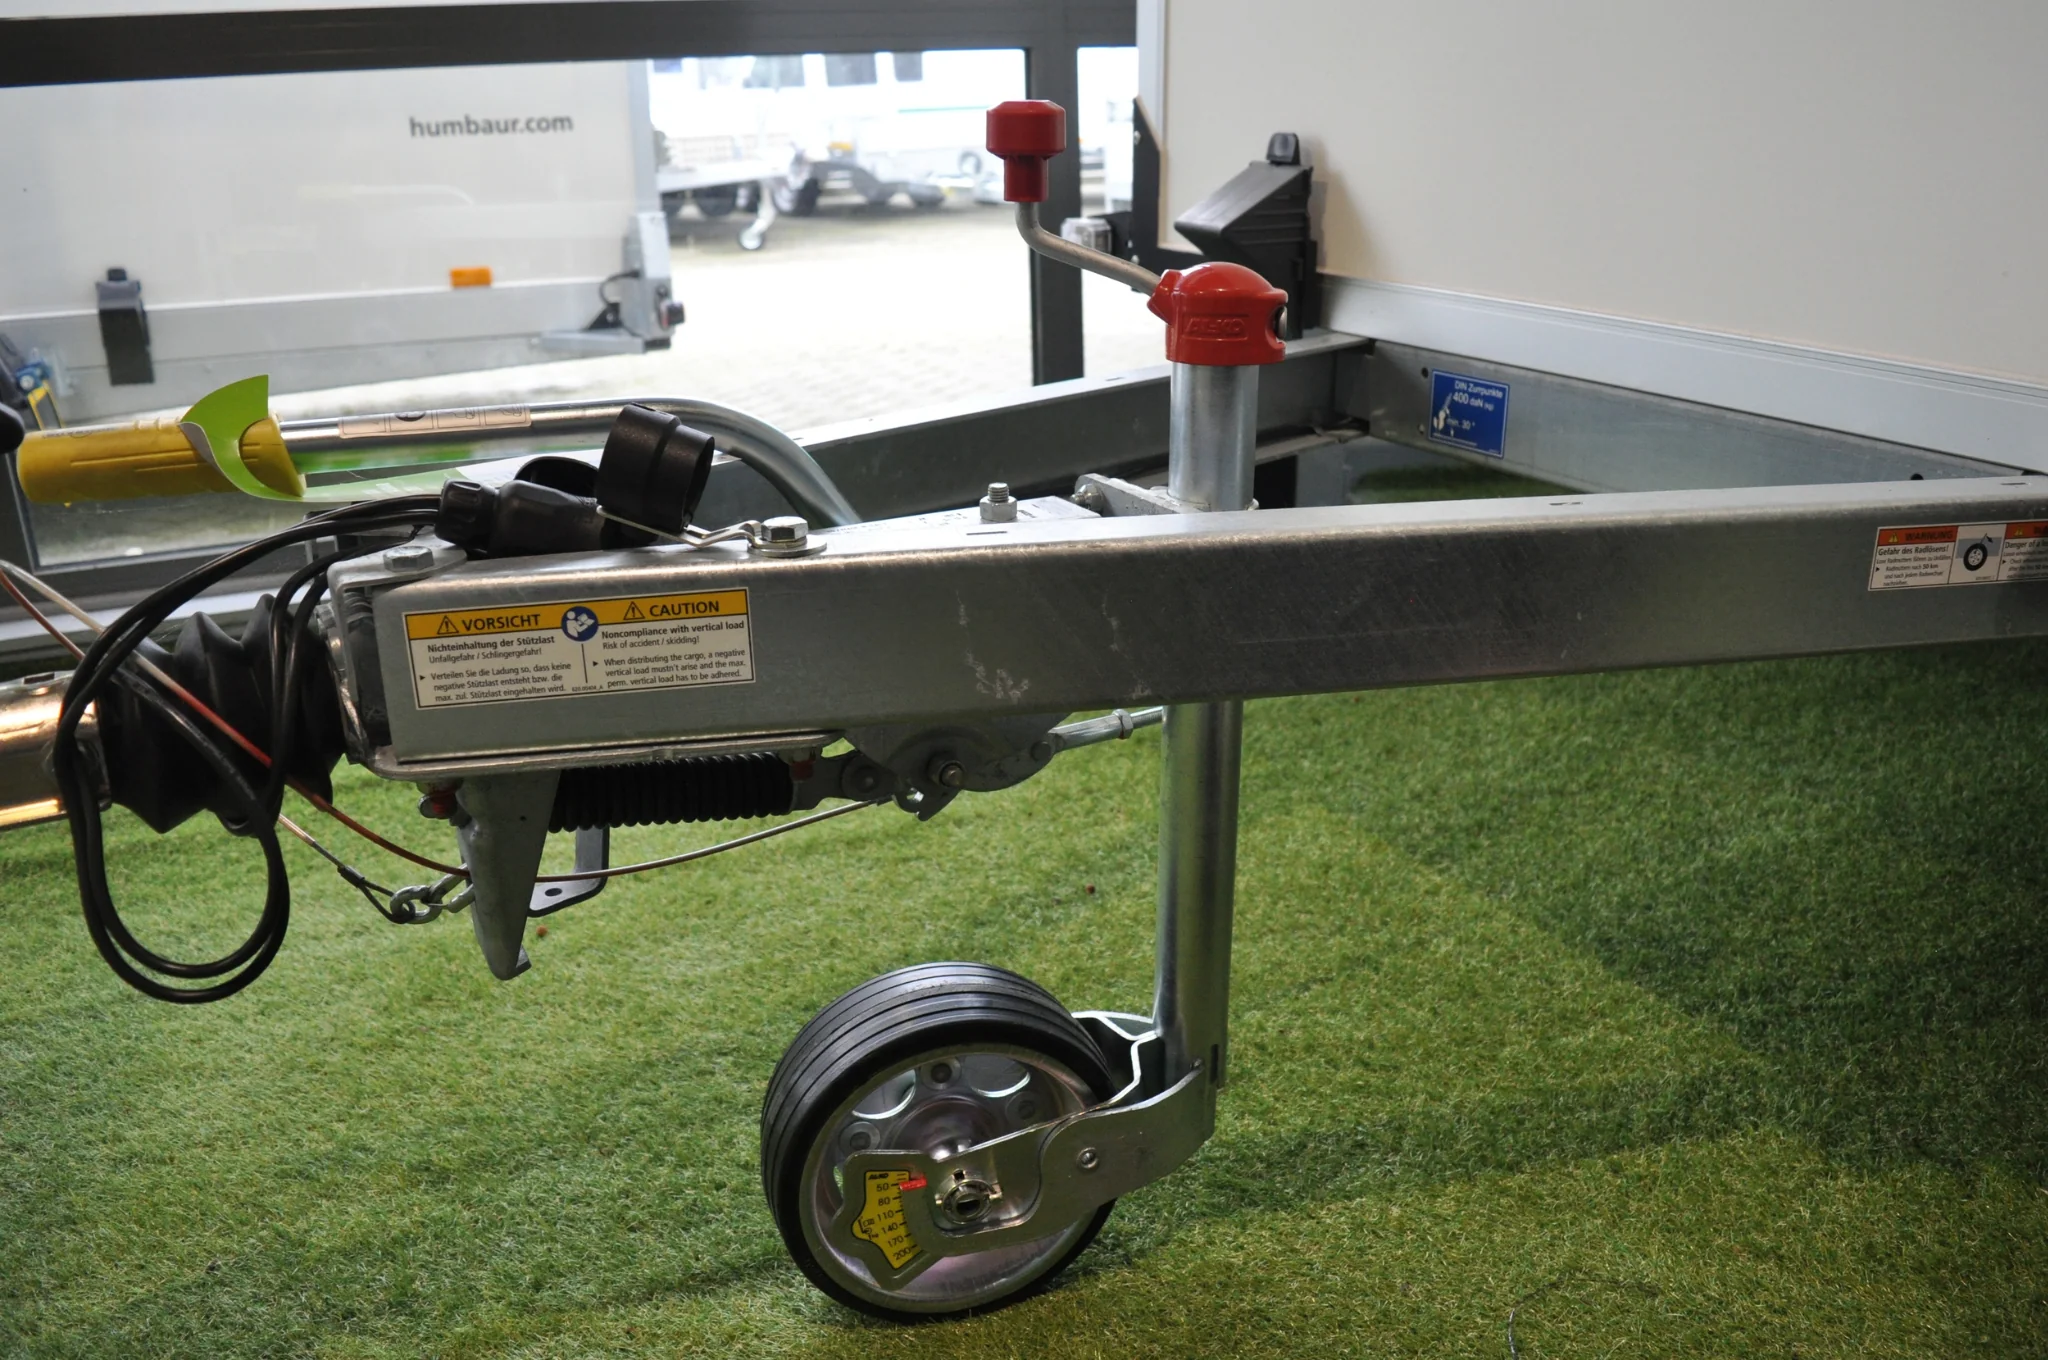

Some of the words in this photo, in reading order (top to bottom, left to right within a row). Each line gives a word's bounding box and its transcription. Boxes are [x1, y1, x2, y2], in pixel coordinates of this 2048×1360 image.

[409, 114, 574, 138] humbaur.com
[1454, 380, 1466, 390] DIN
[1452, 392, 1468, 404] 400
[1878, 548, 1900, 556] Gefahr
[1914, 544, 1949, 554] Radlösens!
[650, 601, 720, 616] CAUTION
[462, 614, 540, 631] VORSICHT
[602, 626, 668, 640] Noncompliance
[670, 625, 690, 634] with
[692, 622, 723, 632] vertical
[726, 620, 744, 630] load
[428, 640, 498, 653] Nichteinhaltung
[500, 639, 514, 648] der
[517, 636, 555, 646] Stützlast
[603, 641, 618, 650] Risk
[620, 640, 628, 648] of
[629, 638, 660, 647] accident
[666, 636, 700, 646] skidding!
[429, 652, 475, 664] Unfallgefahr
[482, 648, 542, 660] Schlingergefahr!
[604, 658, 626, 666] When
[628, 654, 668, 665] distributing
[670, 653, 682, 662] the
[684, 652, 706, 662] cargo,
[714, 648, 746, 659] negative
[431, 671, 464, 680] Verteilen
[466, 669, 476, 678] Sie
[478, 668, 490, 676] die
[492, 666, 518, 678] Ladung
[533, 664, 550, 673] dass
[552, 662, 571, 671] keine
[606, 667, 632, 676] vertical
[634, 666, 650, 674] load
[652, 664, 680, 673] mustn't
[681, 662, 698, 670] arise
[700, 660, 714, 670] and
[716, 660, 726, 668] the
[434, 682, 466, 692] negative
[467, 679, 498, 688] Stützlast
[500, 677, 530, 686] entsteht
[532, 675, 550, 684] bzw.
[607, 680, 628, 688] perm.
[630, 676, 656, 685] vertical
[658, 674, 674, 682] load
[676, 672, 688, 682] has
[700, 671, 708, 680] be
[710, 669, 742, 679] adhered.
[456, 692, 468, 700] zul.
[470, 690, 501, 699] Stützlast
[504, 687, 546, 698] eingehalten
[548, 685, 566, 693] wird.
[876, 1183, 889, 1192] 50
[878, 1196, 890, 1206] 80
[878, 1210, 894, 1222] 110
[882, 1222, 898, 1234] 140
[888, 1236, 904, 1248] 170
[893, 1247, 911, 1260] 200
